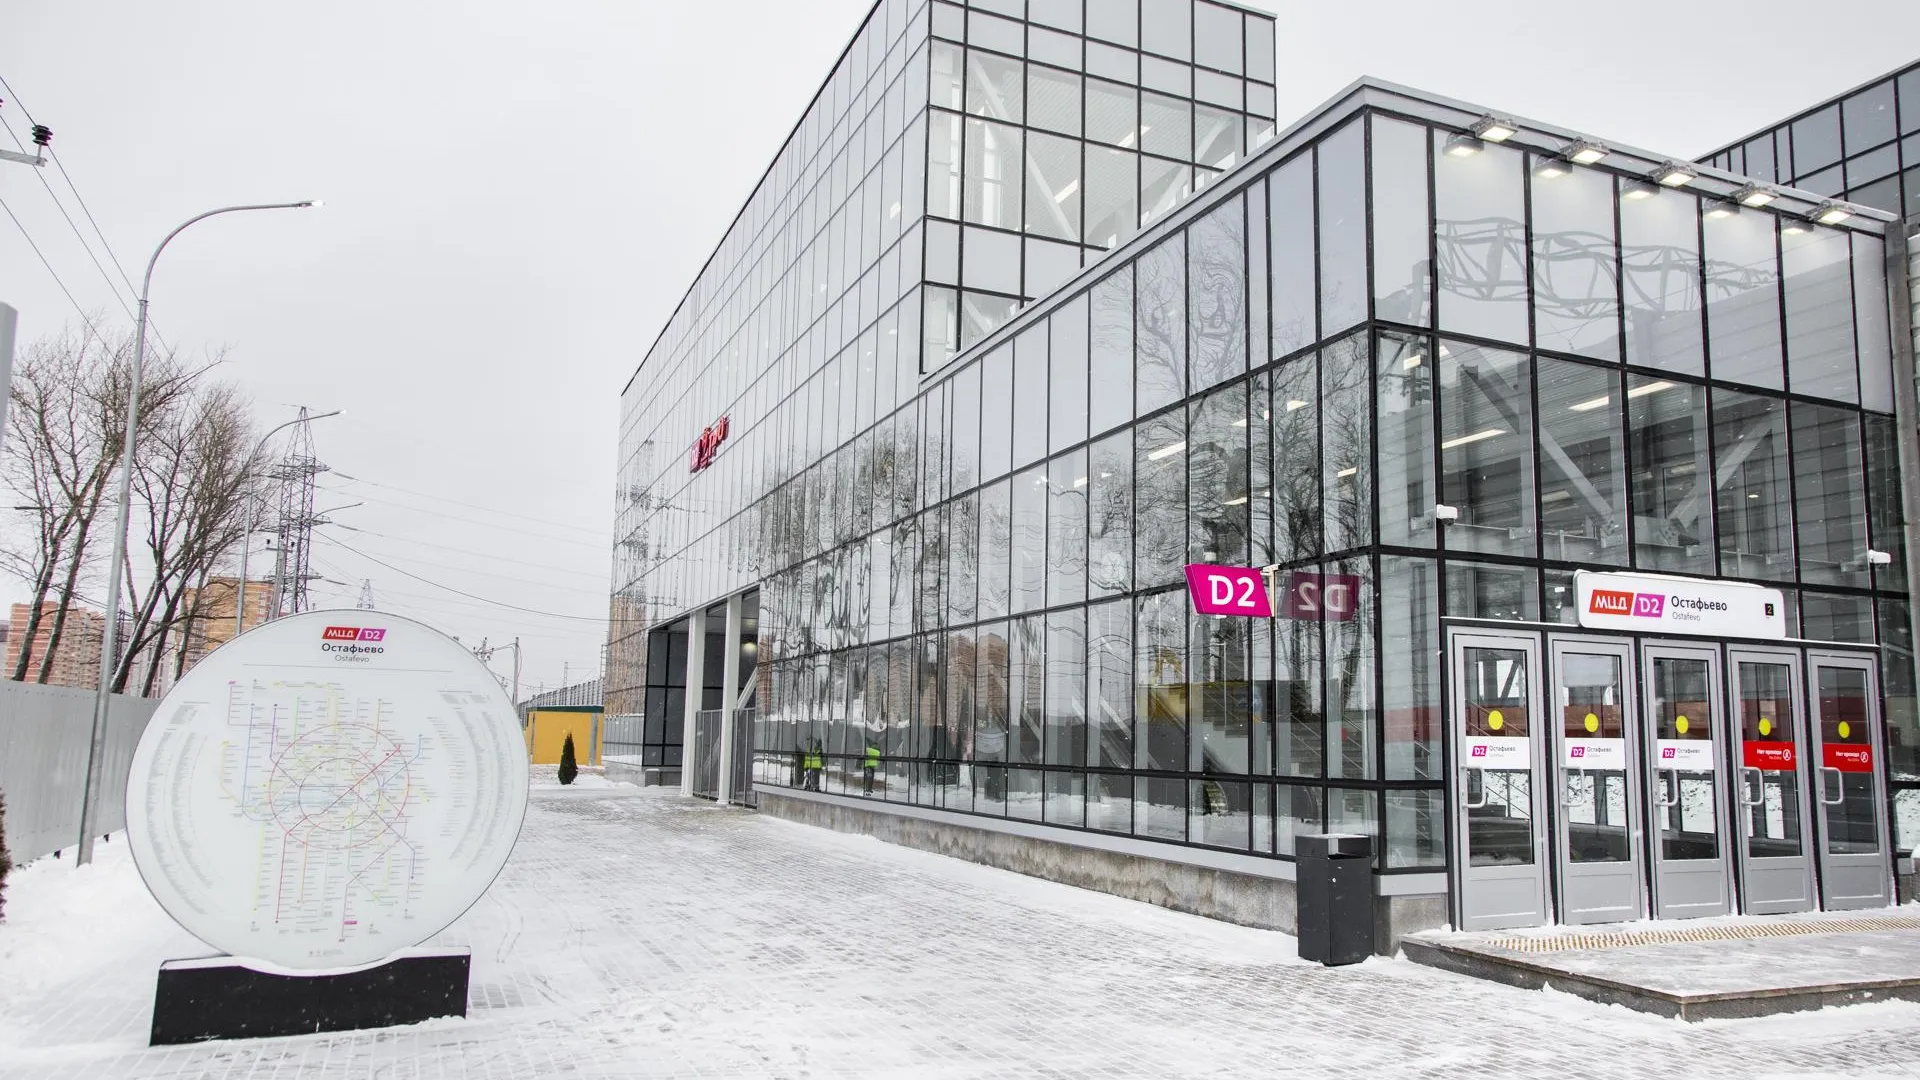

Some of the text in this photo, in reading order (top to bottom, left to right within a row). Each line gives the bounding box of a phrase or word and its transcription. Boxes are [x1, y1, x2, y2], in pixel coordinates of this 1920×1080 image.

[1207, 574, 1256, 608] D2
[1594, 594, 1660, 614] МЦД D2
[1671, 595, 1728, 612] Остафьево
[1672, 611, 1701, 622] Ostafevo
[326, 628, 381, 640] МЦД D2
[321, 642, 385, 655] Остафьево
[334, 654, 370, 663] Ostafevo
